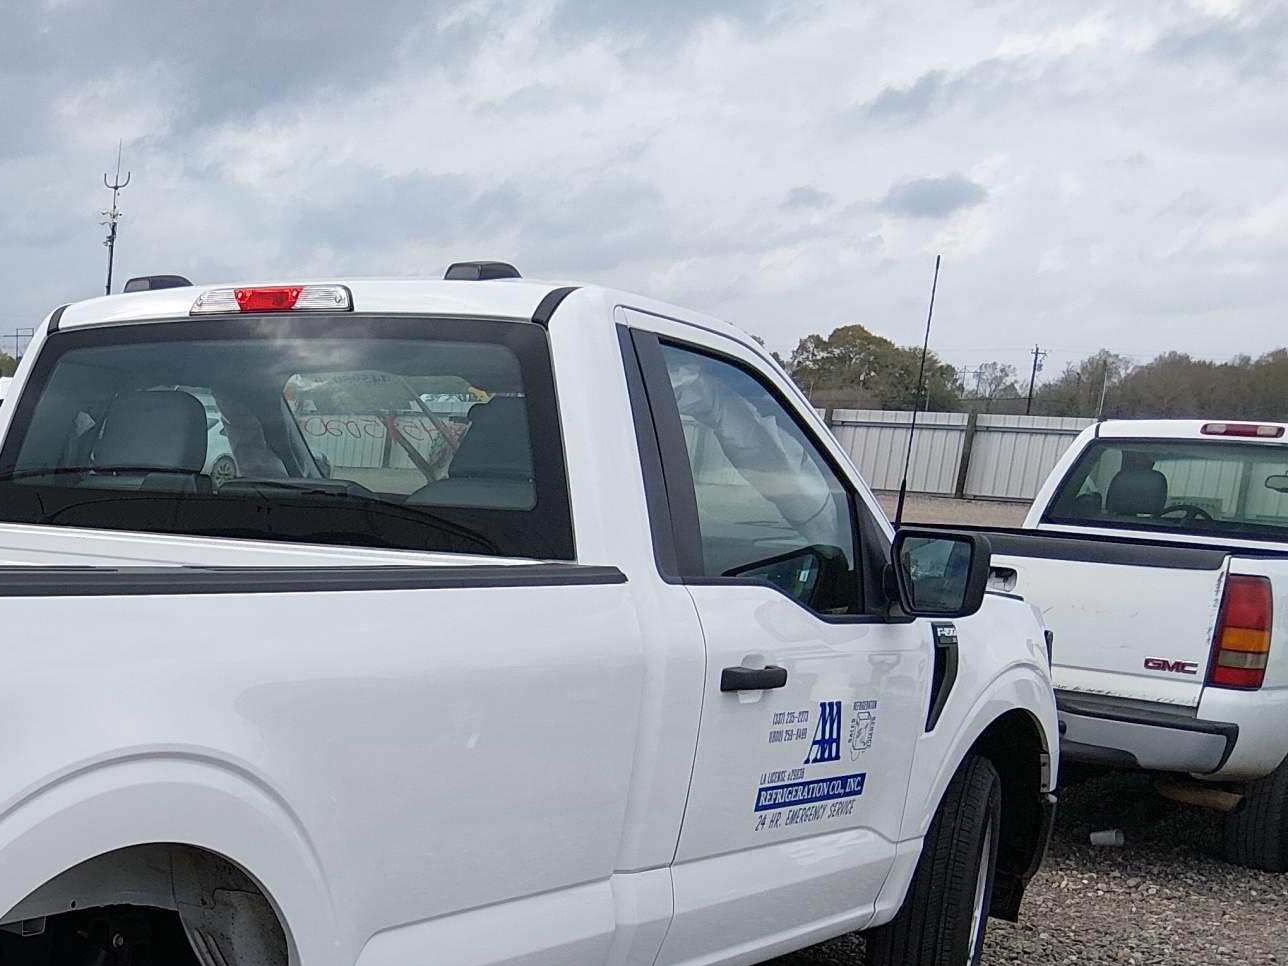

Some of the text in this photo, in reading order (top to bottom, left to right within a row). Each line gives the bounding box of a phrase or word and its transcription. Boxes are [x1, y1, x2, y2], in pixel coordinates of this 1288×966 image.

[1143, 656, 1199, 674] GMC
[759, 782, 830, 806] REFRIGERATION
[755, 800, 856, 831] 24 HR. EMERGENCY SERVICE
